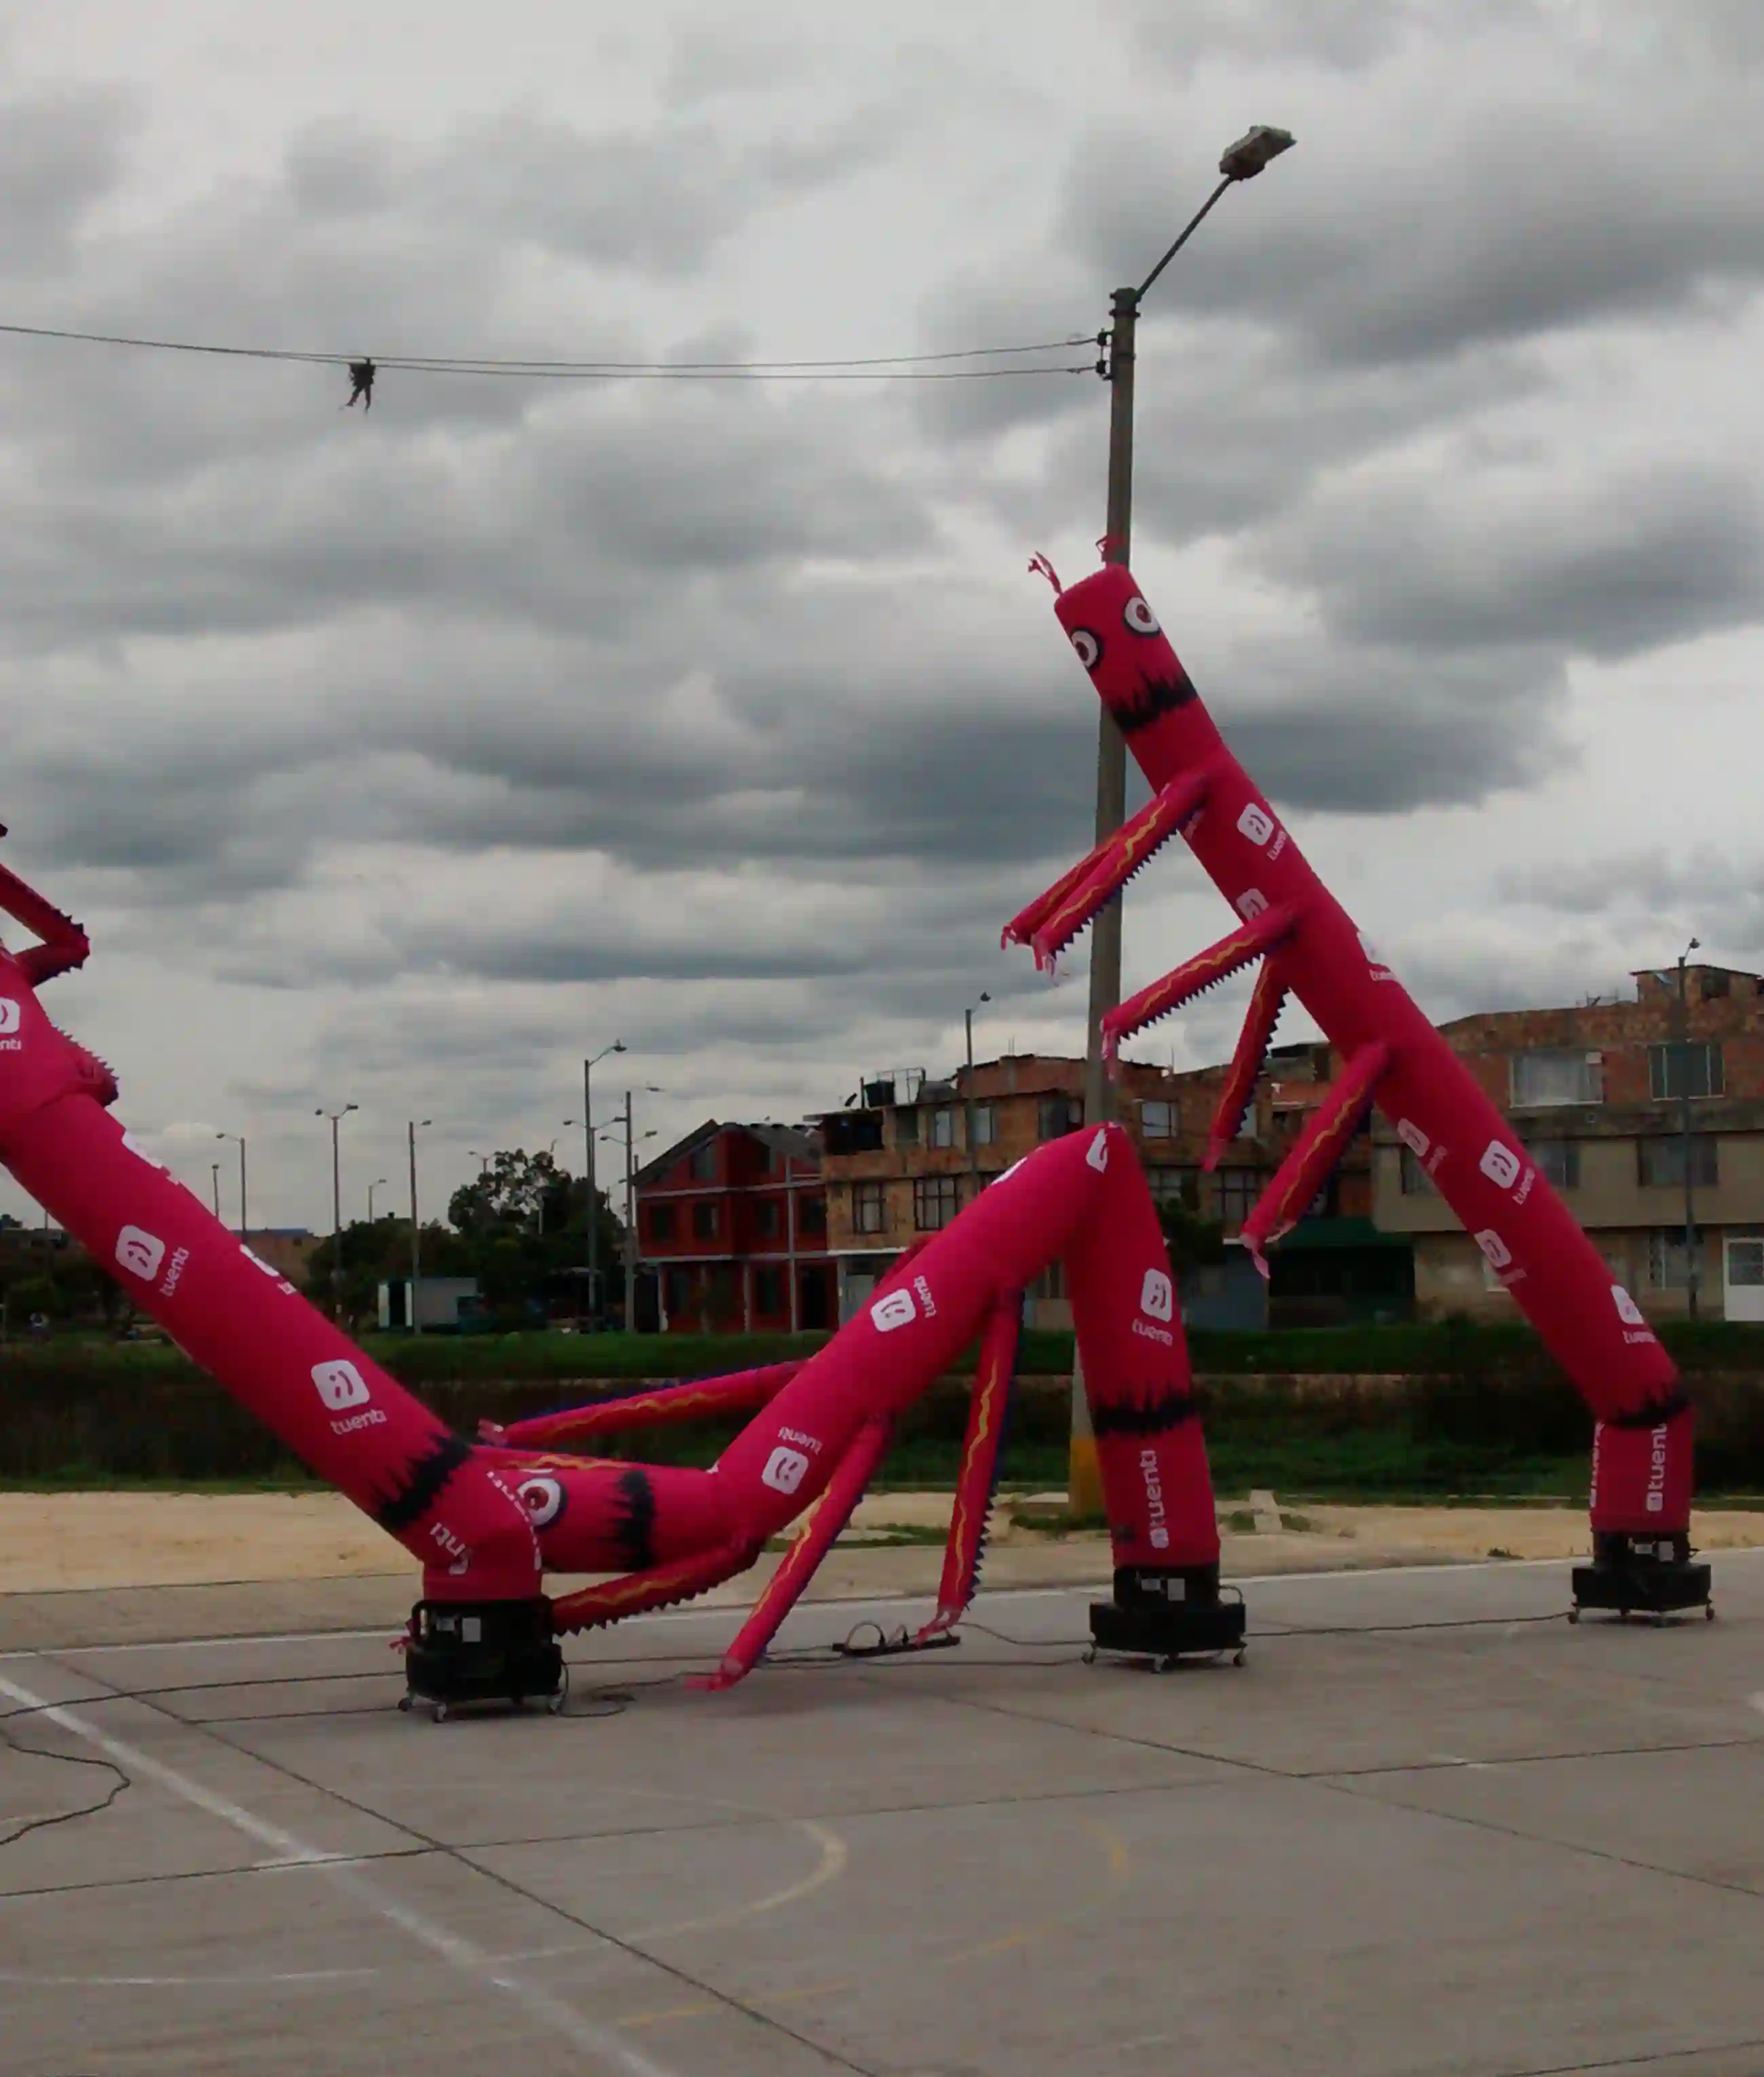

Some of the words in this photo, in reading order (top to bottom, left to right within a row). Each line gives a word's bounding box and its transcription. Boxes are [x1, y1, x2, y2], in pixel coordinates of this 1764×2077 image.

[159, 1247, 190, 1297] tuenti
[330, 1408, 388, 1436] tuenti
[1647, 1423, 1668, 1490] tuent
